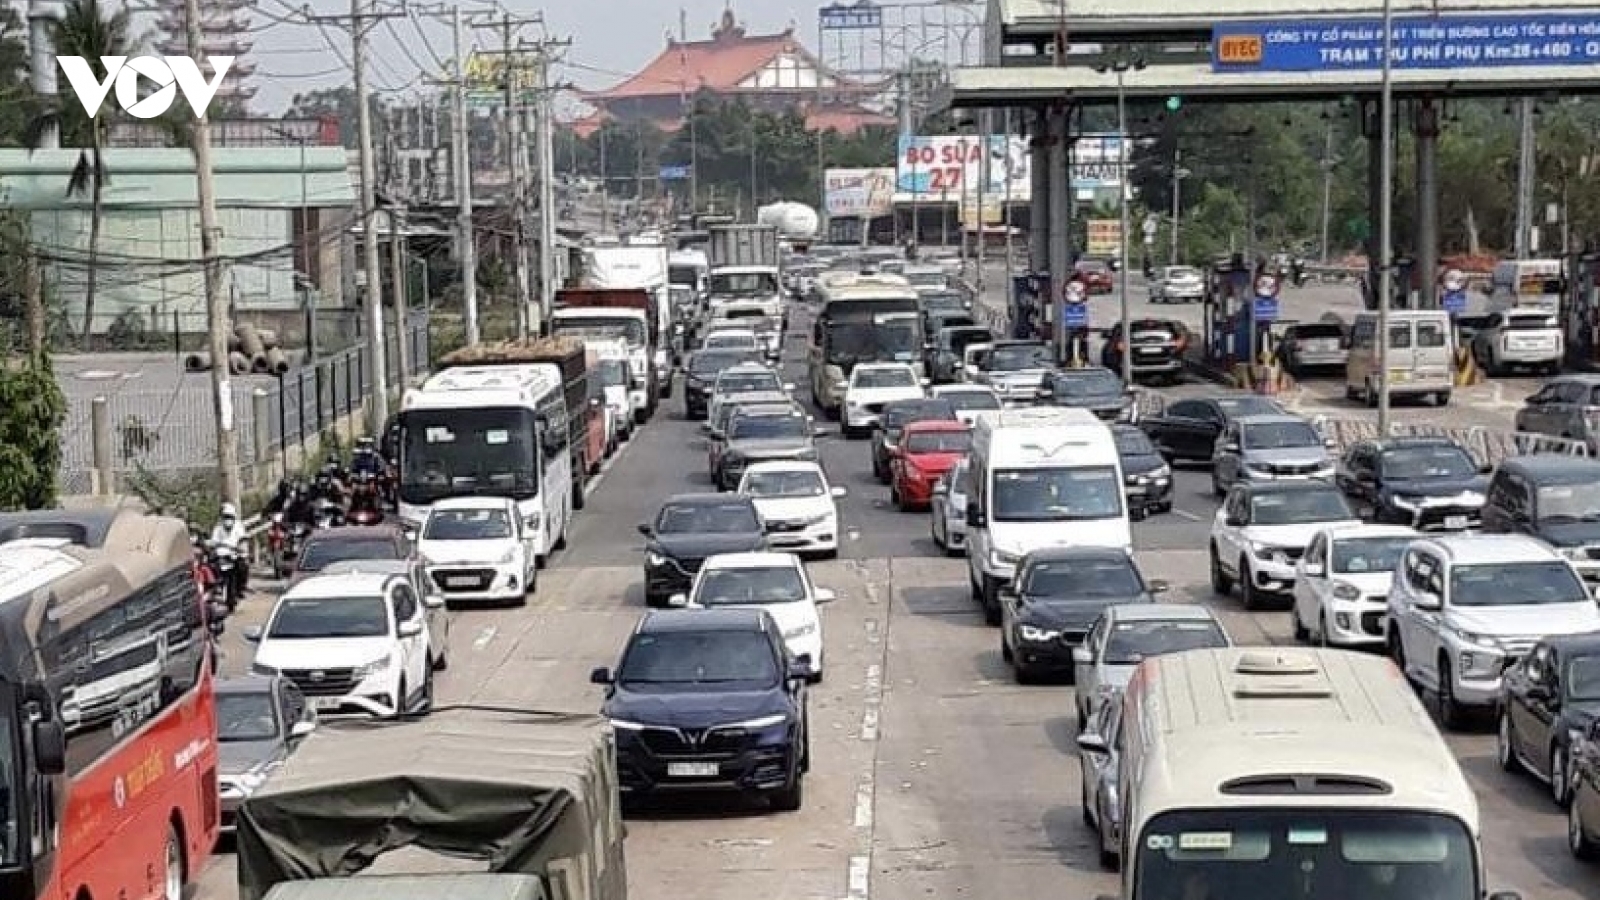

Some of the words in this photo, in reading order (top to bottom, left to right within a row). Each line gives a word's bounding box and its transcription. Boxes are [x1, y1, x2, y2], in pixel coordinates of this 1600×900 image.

[1493, 25, 1519, 38] CAO
[1413, 41, 1441, 61] PHÍ
[930, 167, 961, 190] 27
